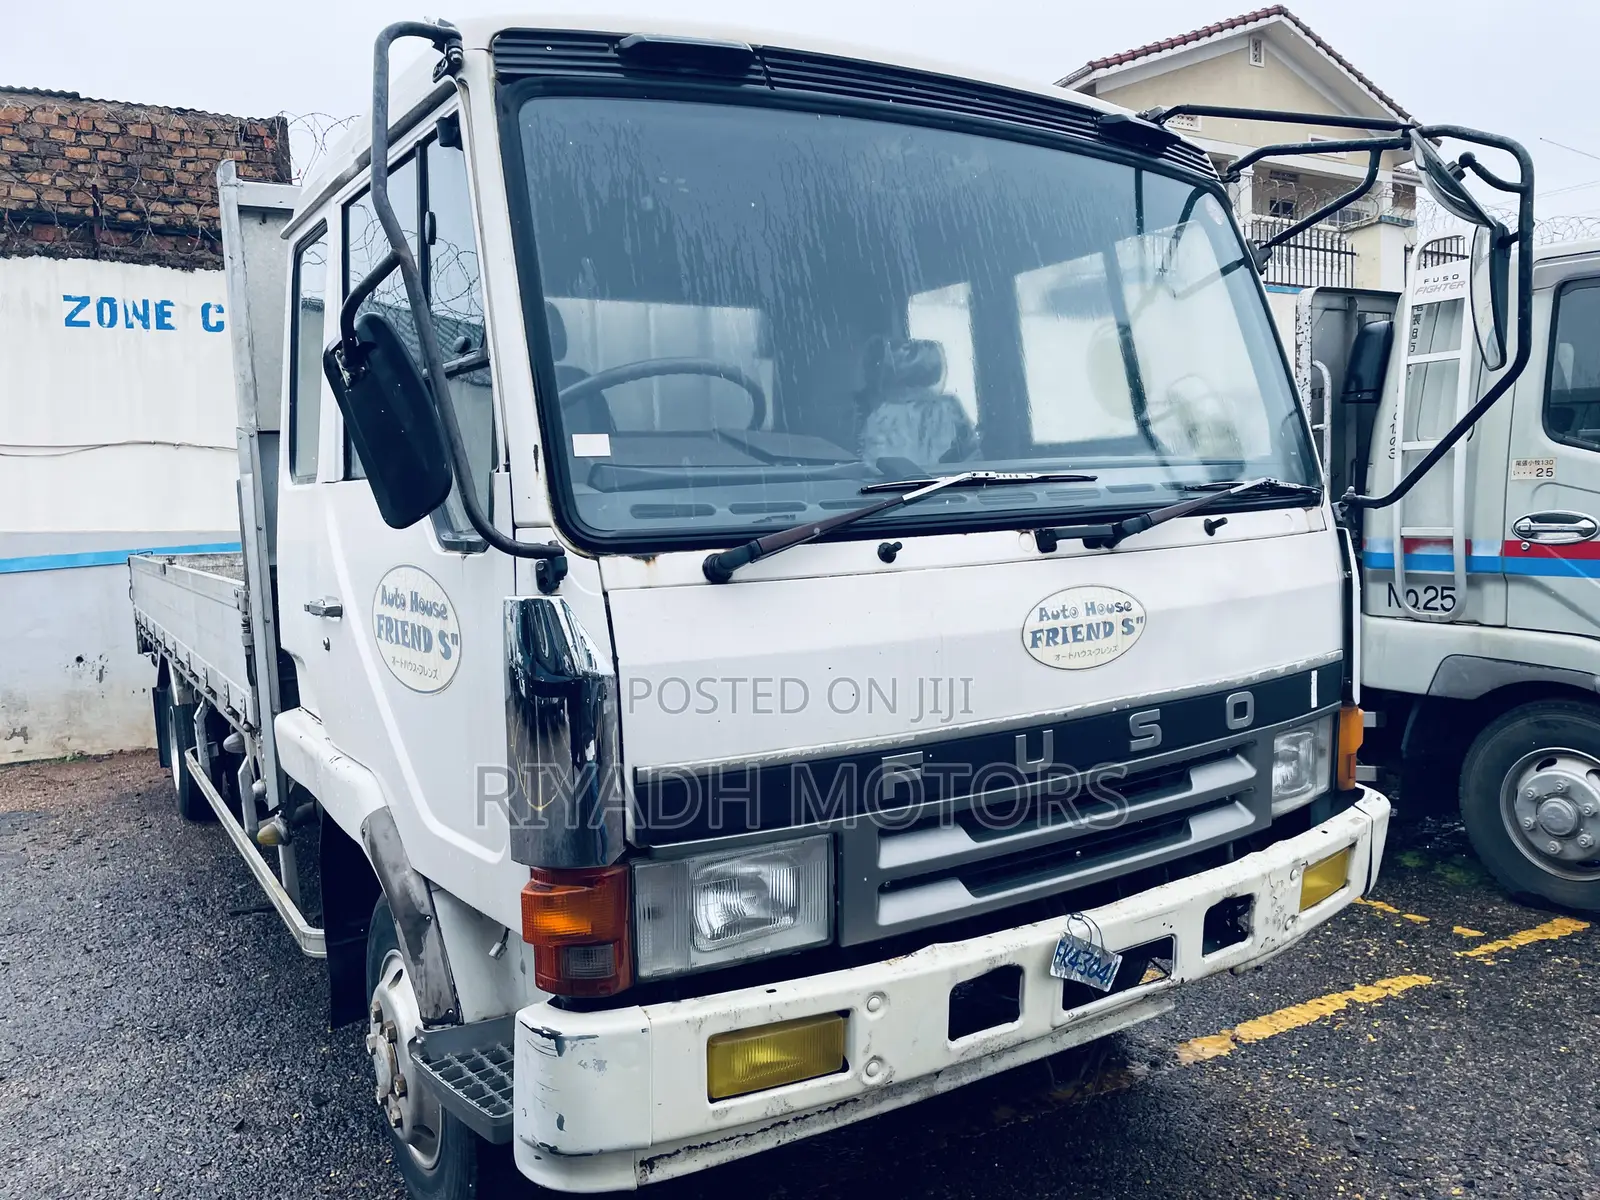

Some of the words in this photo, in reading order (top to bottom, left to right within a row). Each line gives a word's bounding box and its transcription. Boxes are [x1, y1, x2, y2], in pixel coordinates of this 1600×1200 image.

[1415, 281, 1466, 295] FIGHTER
[1424, 274, 1460, 284] FUSO
[63, 295, 177, 331] ZONE
[381, 585, 406, 611] Auto
[409, 591, 448, 620] House
[1038, 604, 1079, 622] Auto
[1085, 601, 1132, 616] House
[882, 690, 1255, 800] FUSO
